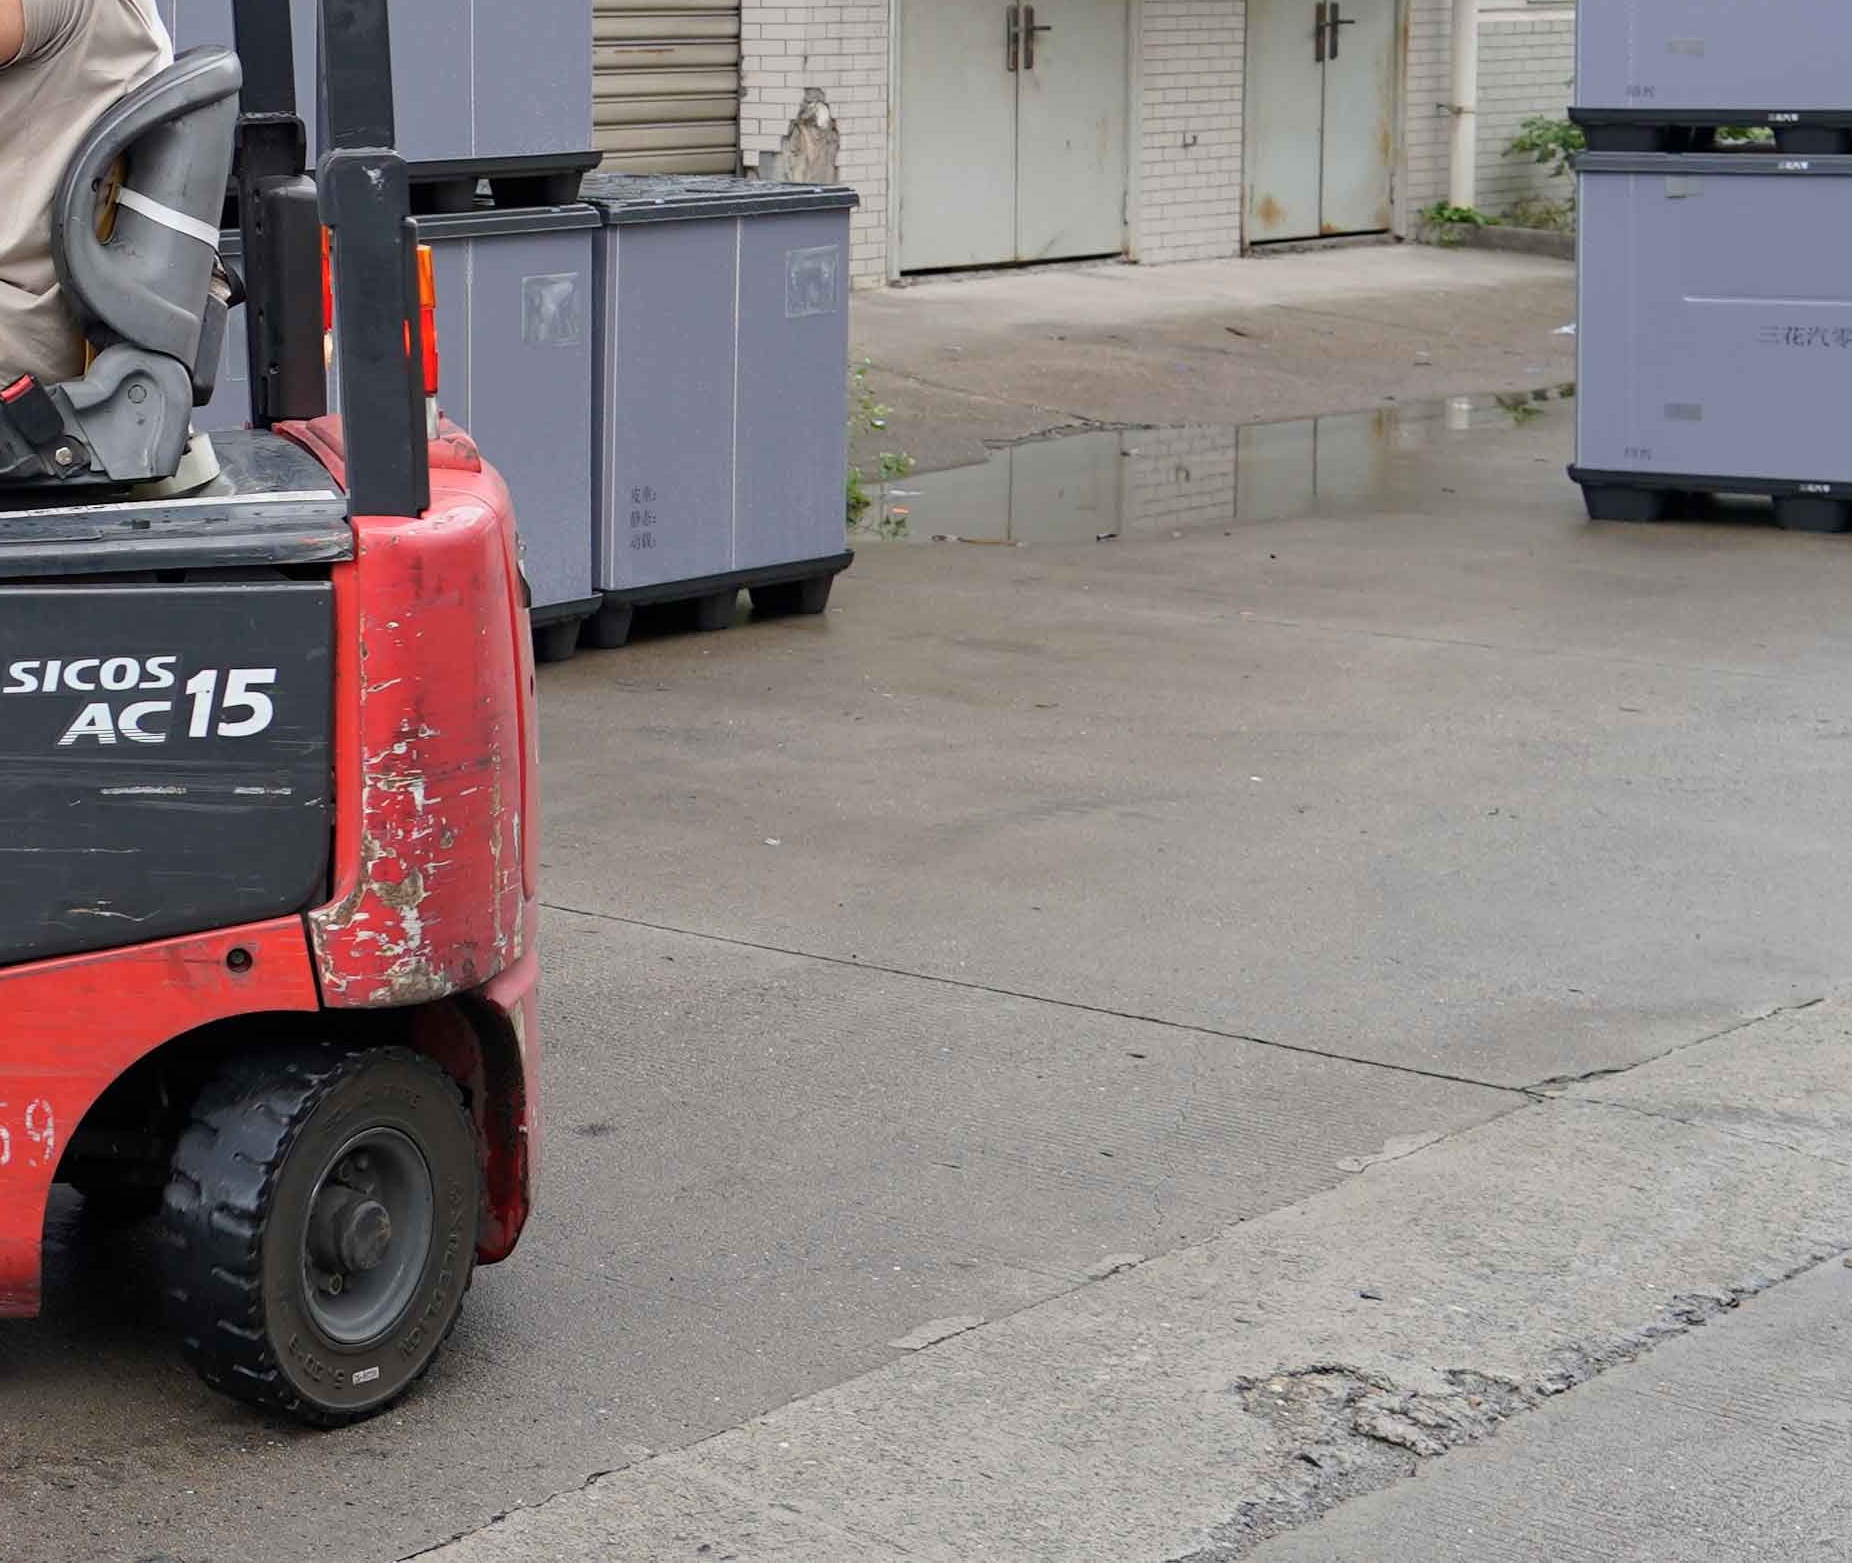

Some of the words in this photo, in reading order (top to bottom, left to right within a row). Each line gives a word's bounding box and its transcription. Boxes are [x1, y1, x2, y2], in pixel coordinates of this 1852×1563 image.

[2, 654, 178, 695] SICOS
[57, 700, 172, 746] AC
[185, 668, 277, 738] 15
